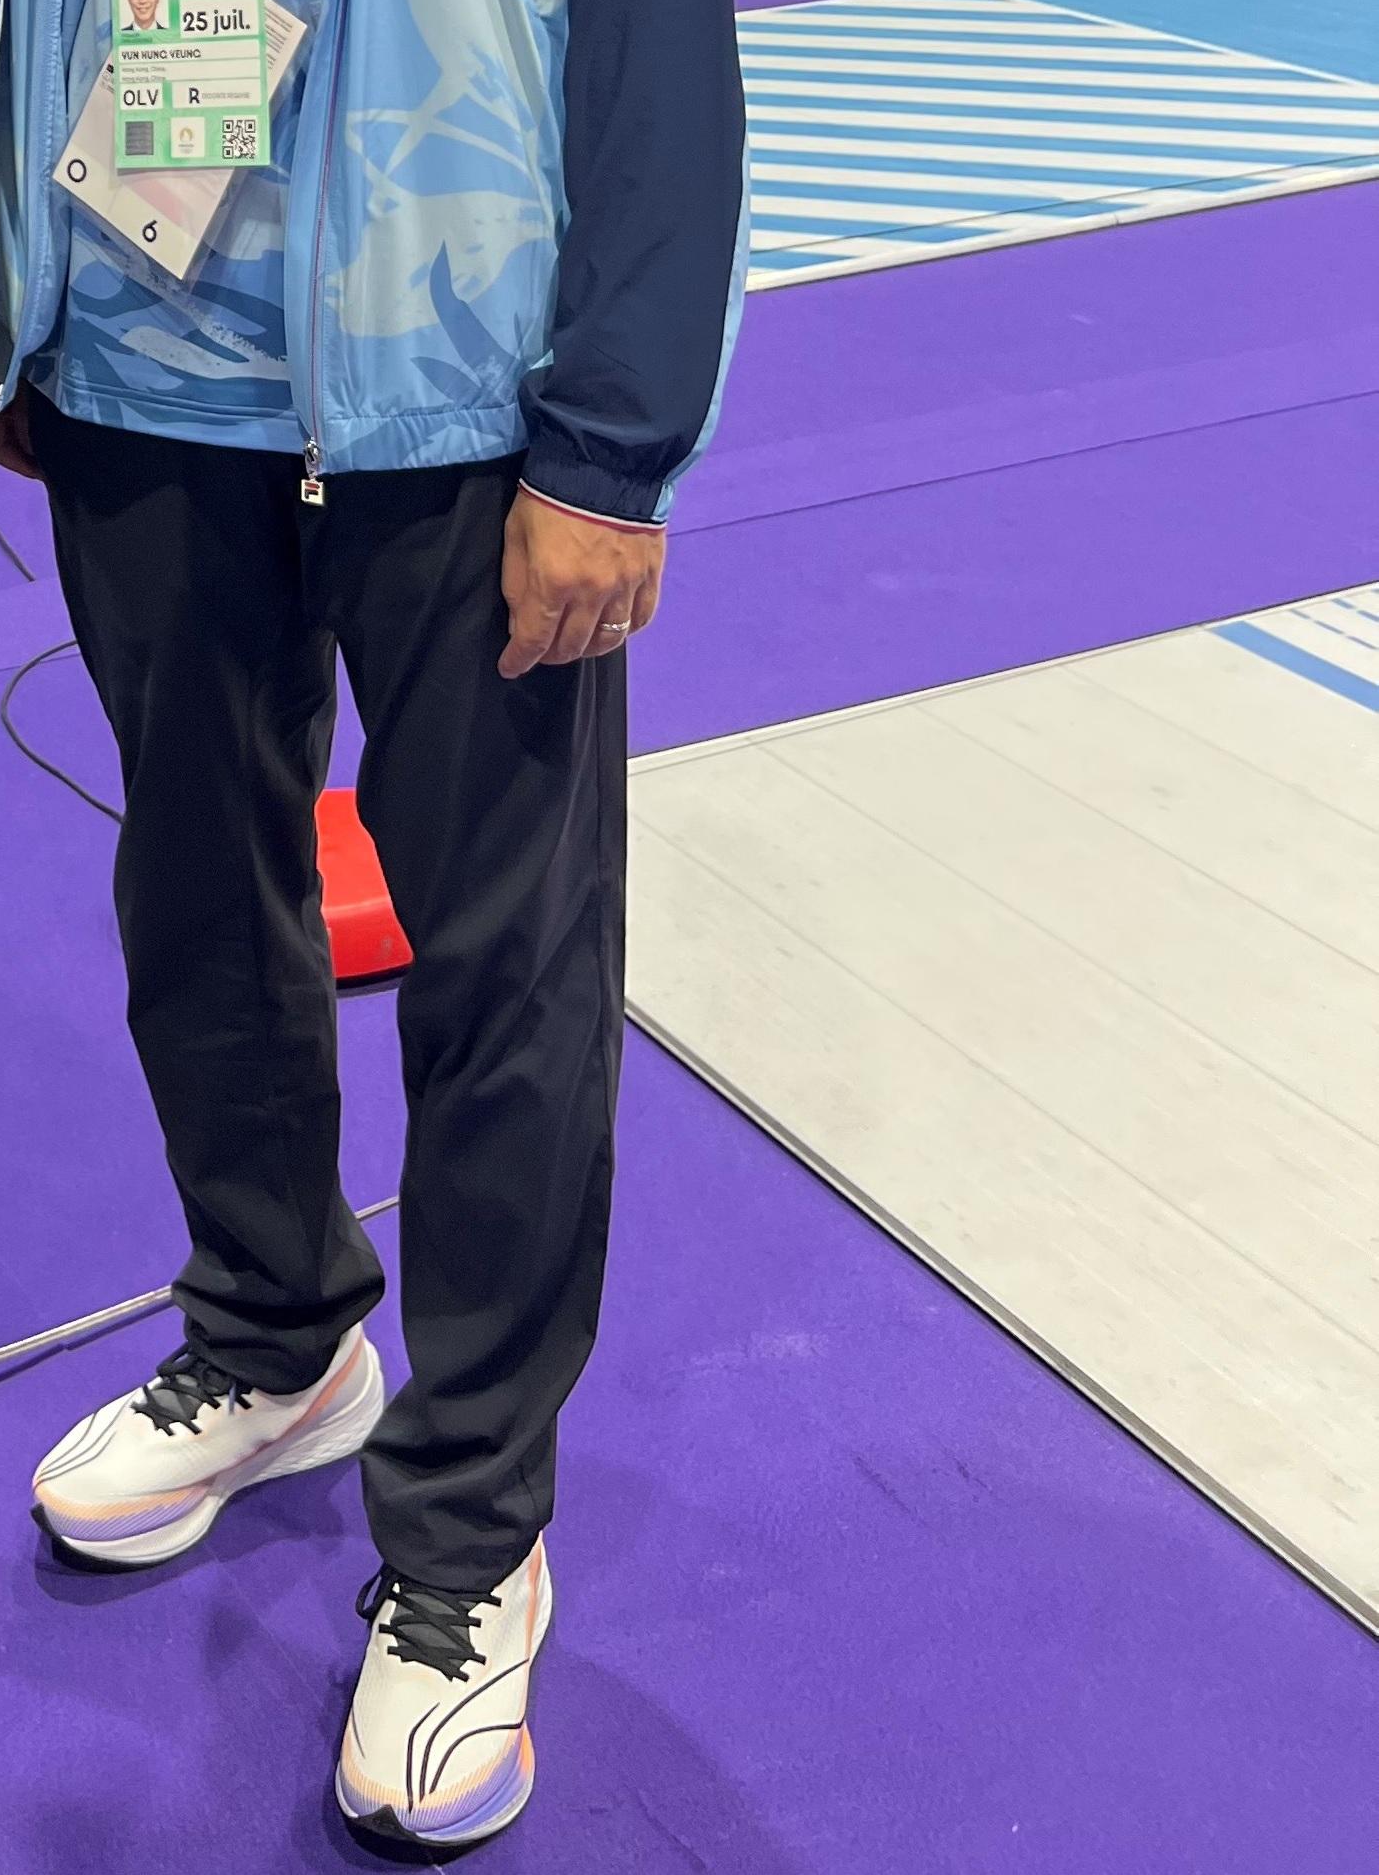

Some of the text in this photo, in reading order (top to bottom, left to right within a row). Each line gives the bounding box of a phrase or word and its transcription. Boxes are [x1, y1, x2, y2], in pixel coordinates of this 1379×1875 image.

[183, 8, 251, 35] 25 juil.
[123, 89, 159, 106] OLV
[188, 87, 200, 104] R
[142, 219, 158, 243] 6
